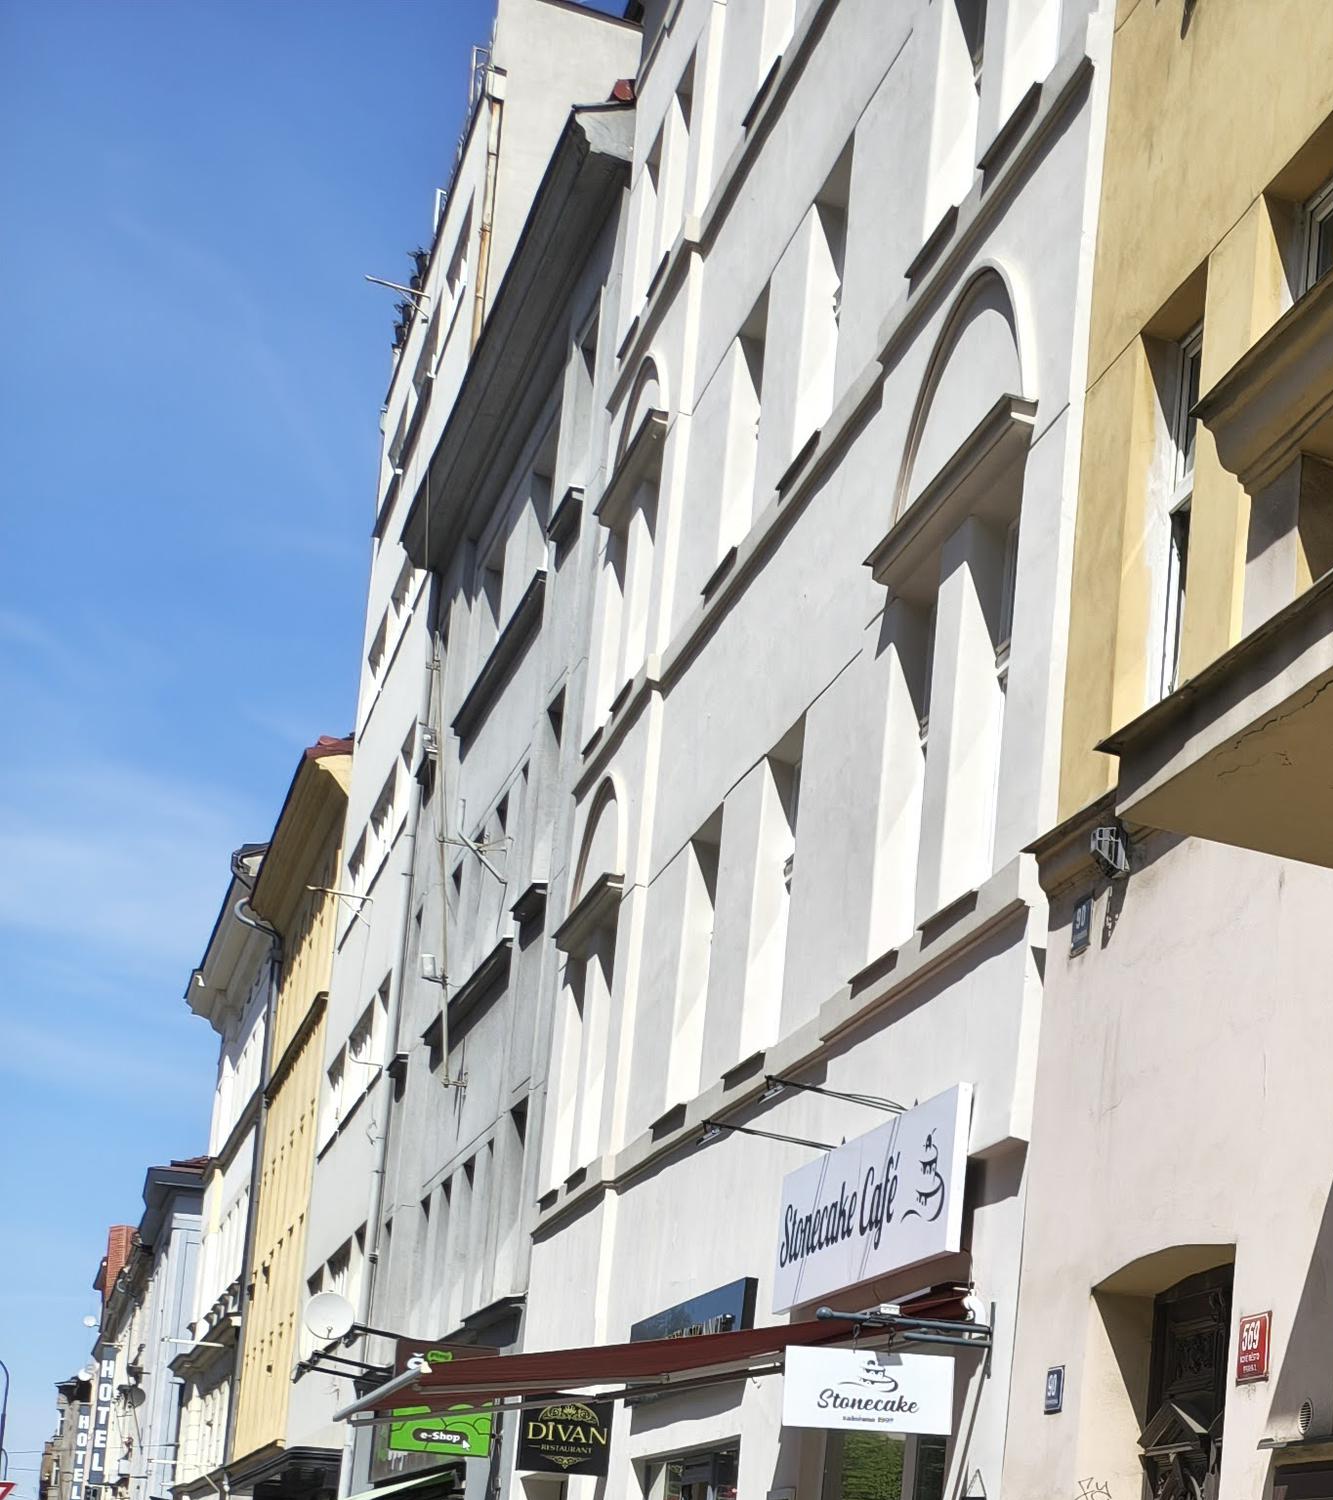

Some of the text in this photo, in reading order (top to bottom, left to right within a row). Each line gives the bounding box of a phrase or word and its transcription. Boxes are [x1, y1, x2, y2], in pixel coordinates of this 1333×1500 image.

[1075, 904, 1086, 928] 90
[780, 1151, 901, 1268] Stonecake Café
[1242, 1320, 1260, 1351] 569
[1047, 1374, 1057, 1396] 90
[817, 1388, 920, 1414] Stonecake
[92, 1359, 115, 1472] HOTEL
[420, 1431, 461, 1443] e-Shop
[540, 1443, 592, 1454] RESTAURANT
[71, 1414, 90, 1500] HOTEL
